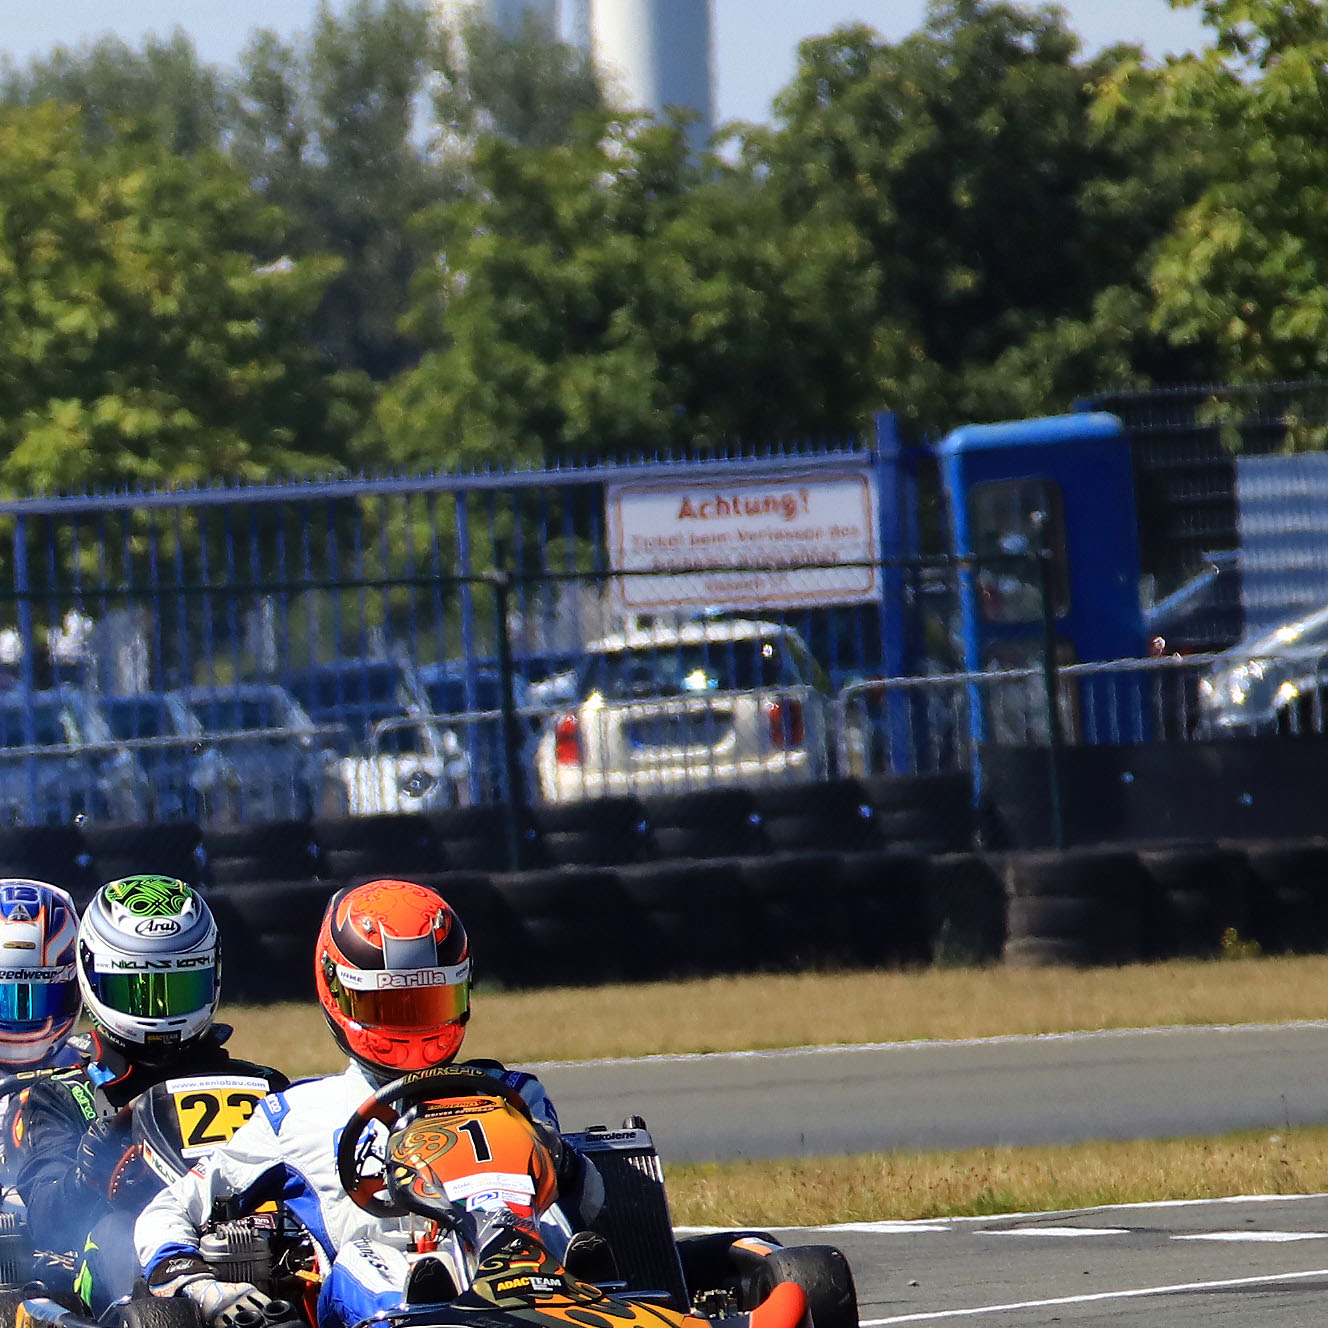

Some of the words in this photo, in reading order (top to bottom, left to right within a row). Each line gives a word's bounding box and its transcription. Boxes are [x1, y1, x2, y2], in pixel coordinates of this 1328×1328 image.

[678, 487, 809, 522] Achtung!
[143, 919, 176, 932] Arai
[377, 970, 446, 988] Parilla
[456, 1119, 494, 1163] 1
